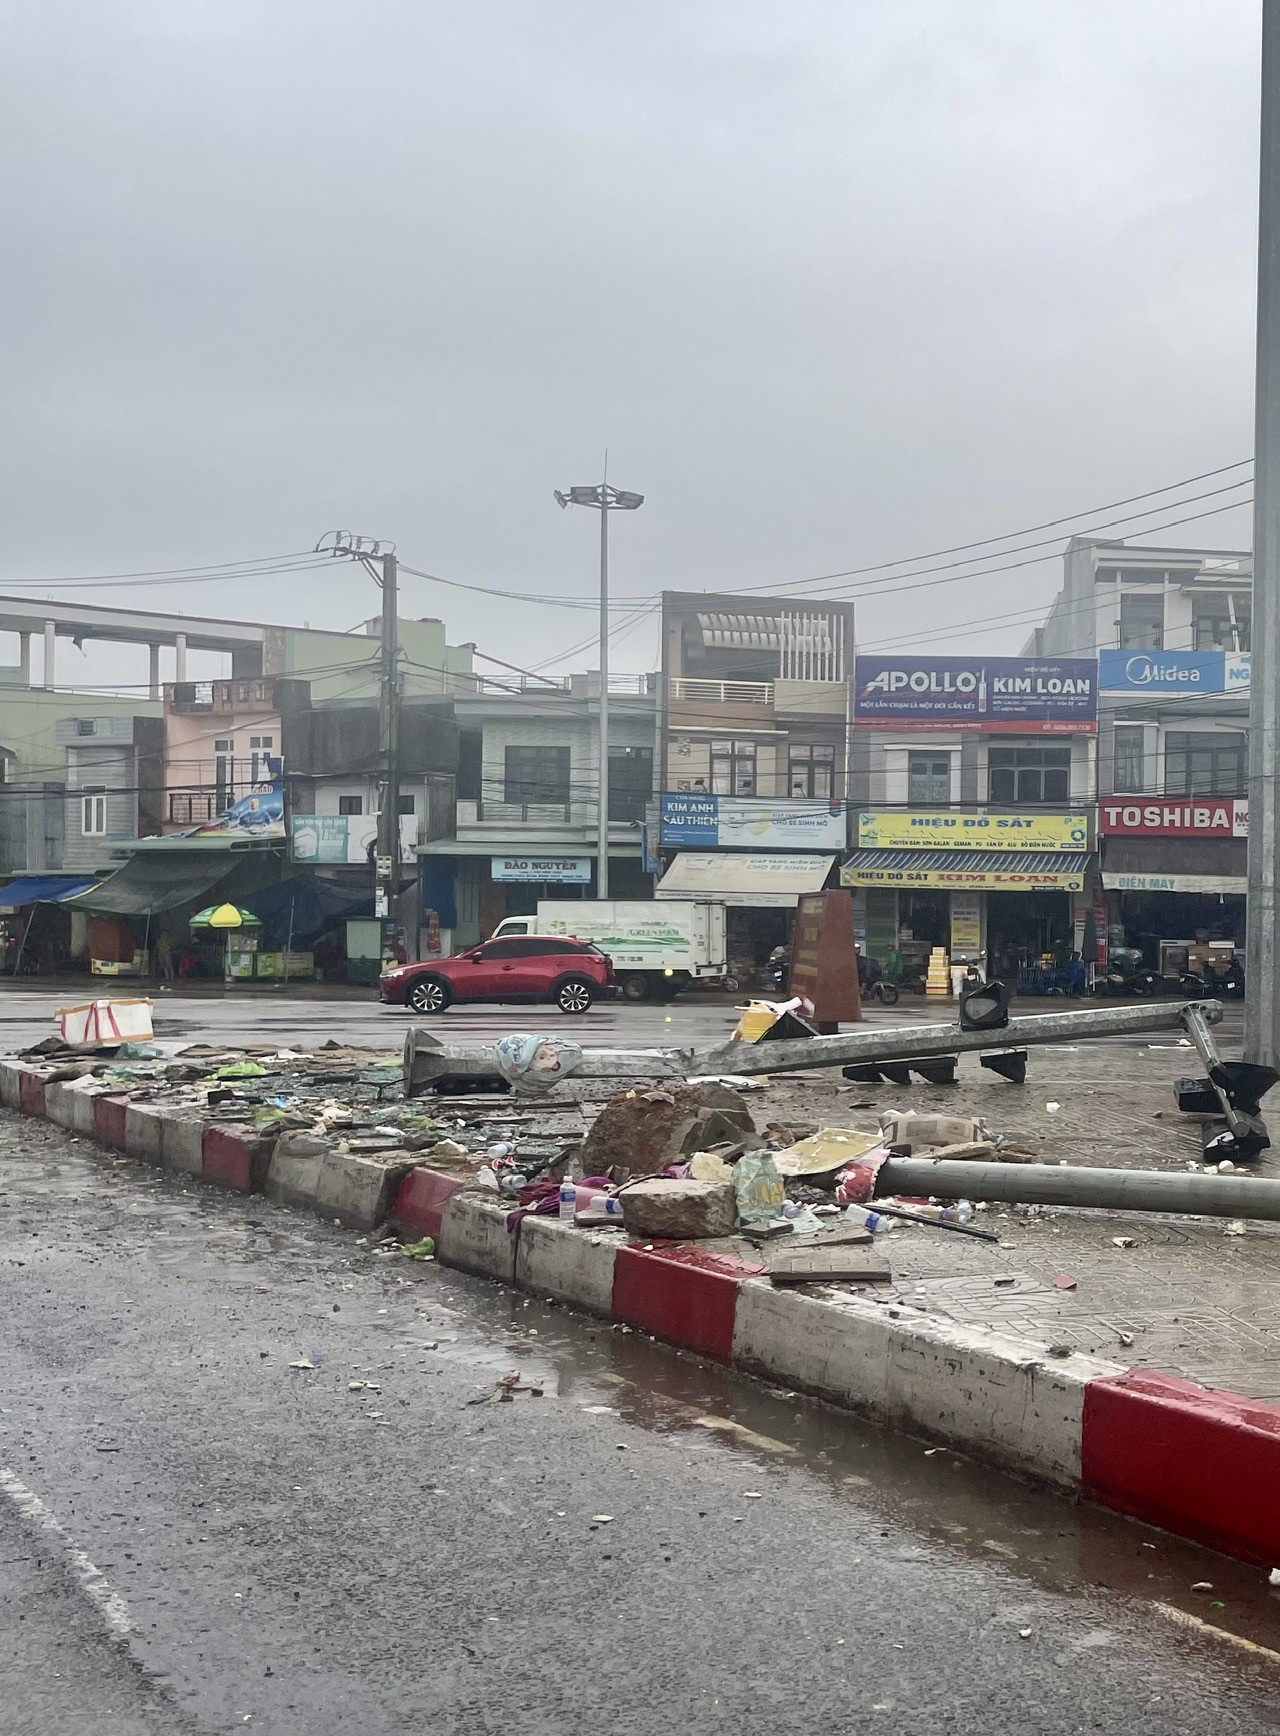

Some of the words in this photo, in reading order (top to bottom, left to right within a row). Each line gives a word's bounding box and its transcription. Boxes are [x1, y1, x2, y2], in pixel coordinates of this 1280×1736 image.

[1126, 655, 1200, 685] Midea
[862, 671, 977, 694] APOLLO
[993, 677, 1031, 693] KIM
[1037, 678, 1090, 694] LOAN
[667, 803, 687, 812] KIM
[690, 803, 714, 813] ANH
[911, 817, 957, 829] HIỆU
[1104, 806, 1230, 828] TOSHIBA
[504, 859, 528, 869] ĐÀO
[532, 860, 577, 870] NGUYÊN
[857, 871, 884, 881] HIỆU
[937, 873, 986, 882] KIM
[994, 874, 1060, 883] LOAN
